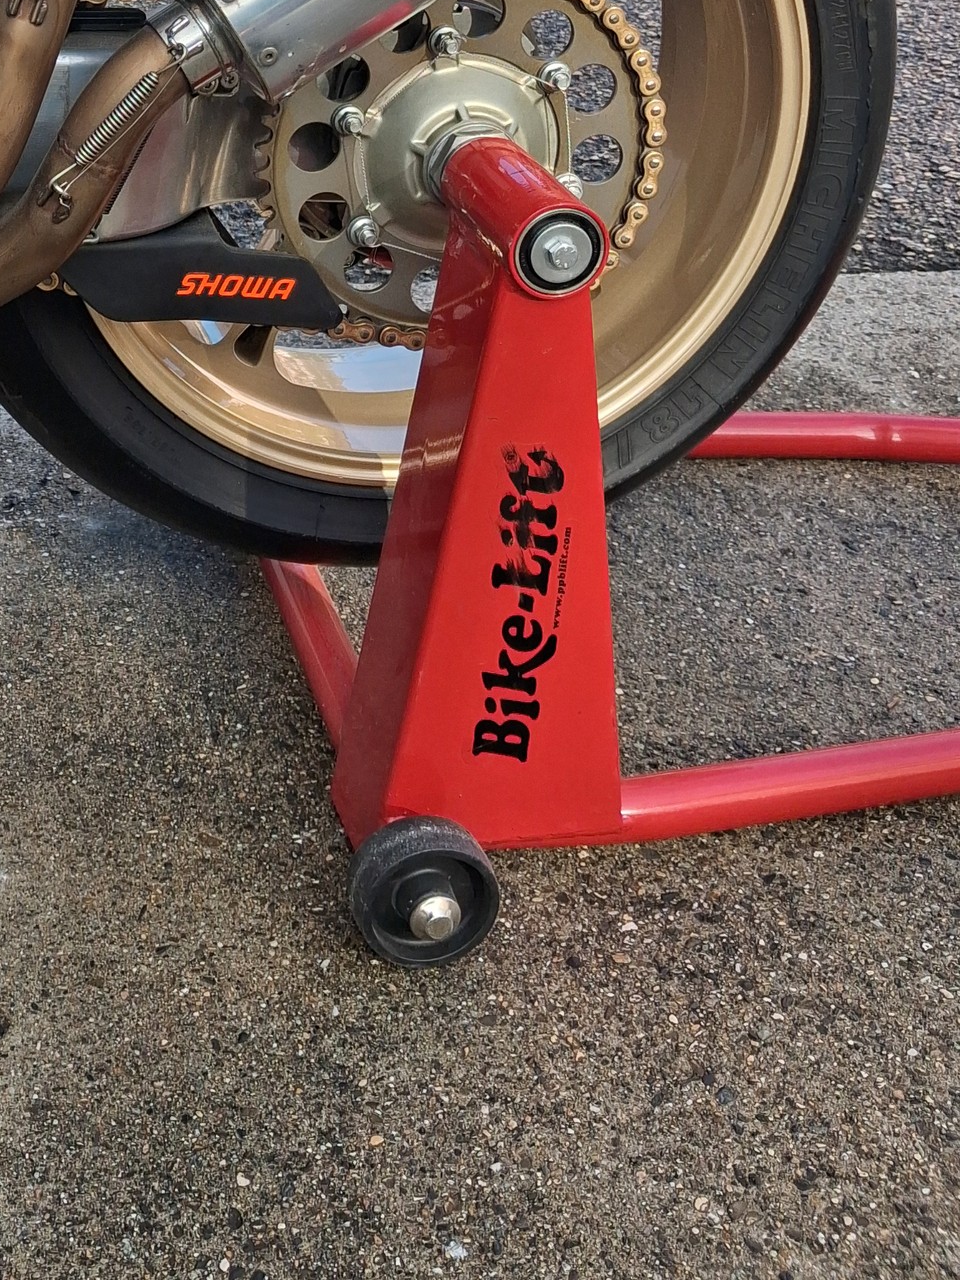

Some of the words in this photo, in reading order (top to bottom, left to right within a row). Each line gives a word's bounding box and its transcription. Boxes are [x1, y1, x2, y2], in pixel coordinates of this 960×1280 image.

[176, 271, 296, 300] SHOWA
[471, 441, 565, 763] Bike-Lift
[553, 527, 572, 629] www.ppblift.com
